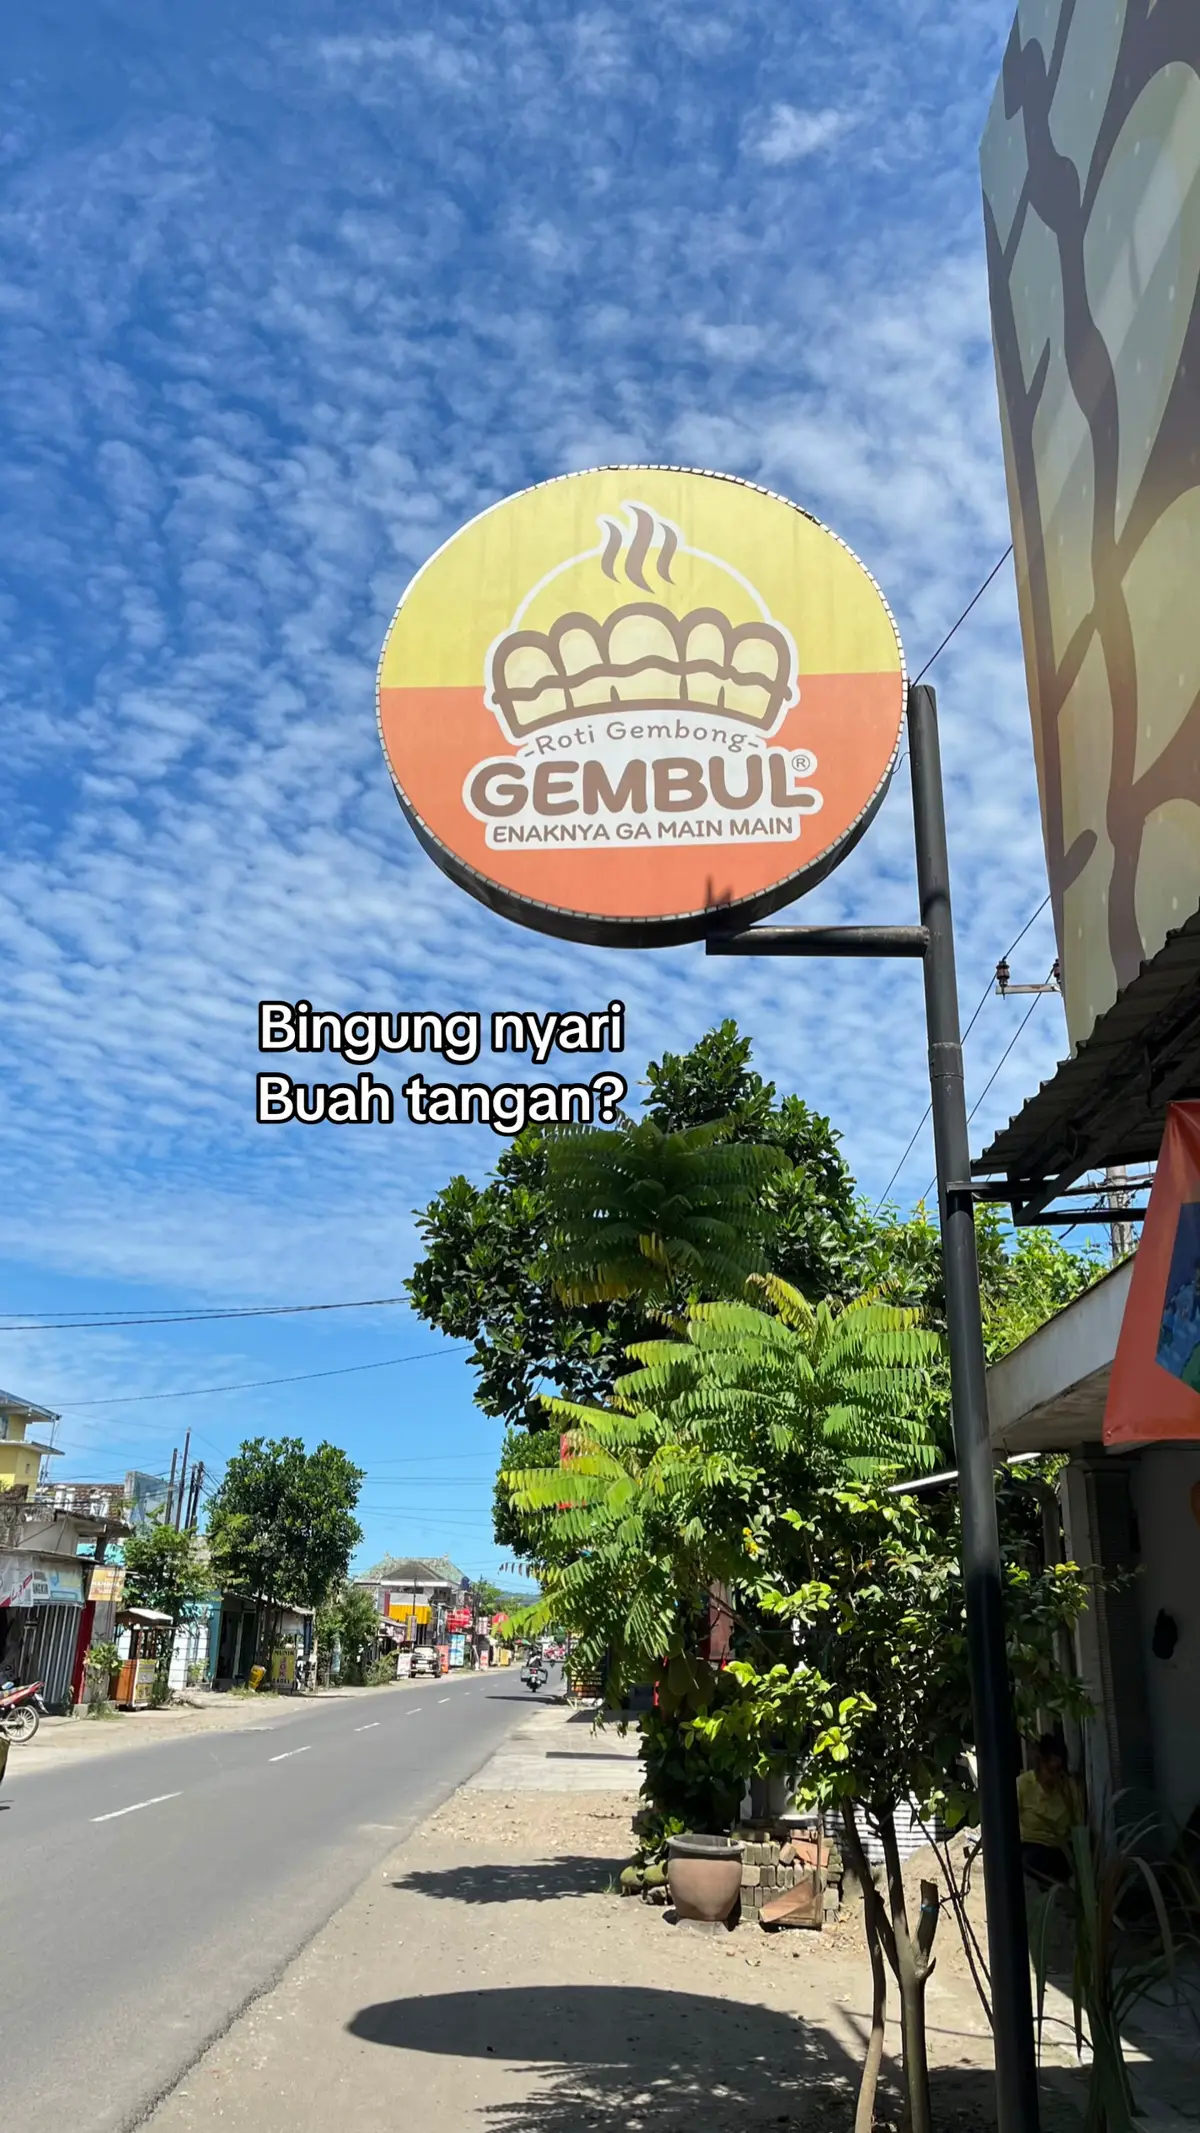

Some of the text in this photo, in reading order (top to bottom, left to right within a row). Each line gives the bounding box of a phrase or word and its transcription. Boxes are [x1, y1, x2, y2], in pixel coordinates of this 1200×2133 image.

[492, 817, 793, 843] ENAKNYA GA MAIN MAIN
